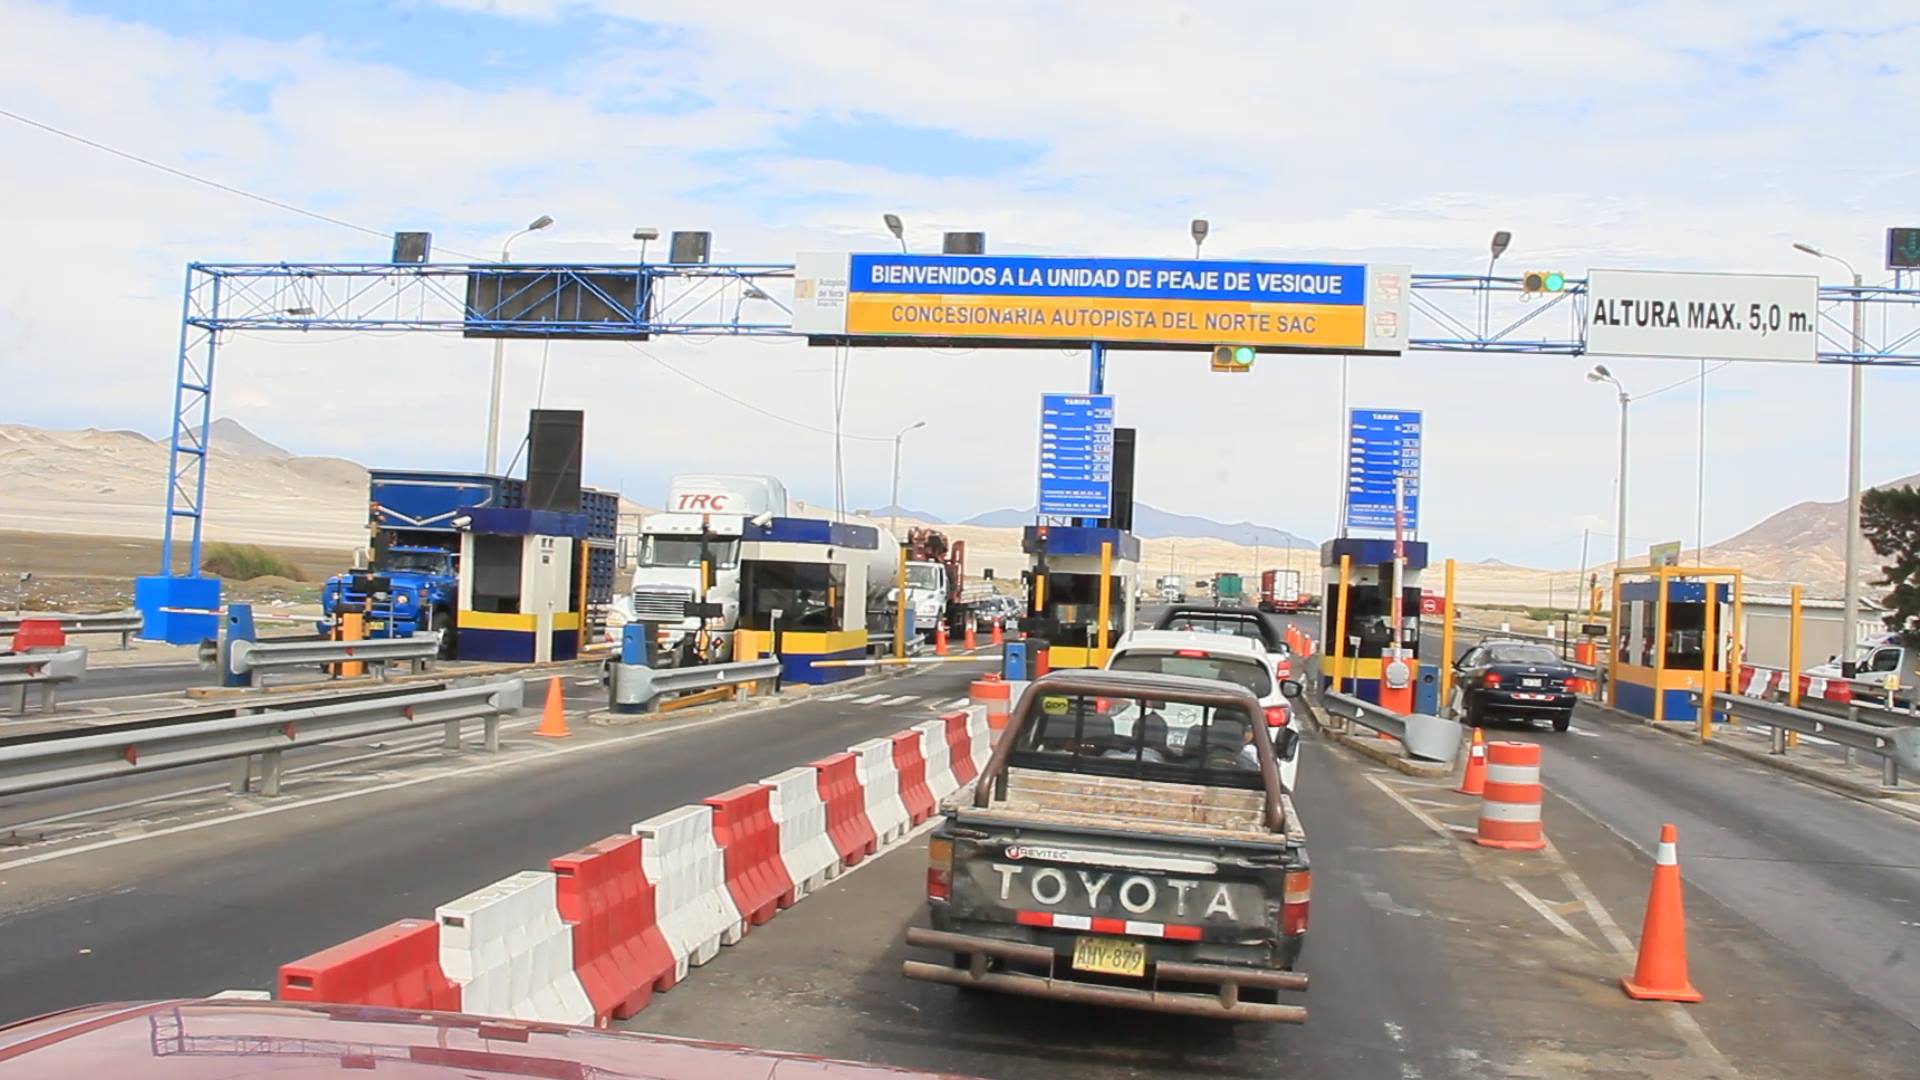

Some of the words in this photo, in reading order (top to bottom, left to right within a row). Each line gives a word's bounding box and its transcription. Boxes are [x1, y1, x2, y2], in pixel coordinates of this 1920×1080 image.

[871, 264, 996, 286] BIENVENIDOS
[1000, 268, 1014, 286] A
[1018, 268, 1047, 287] LA
[1048, 269, 1120, 288] UNIDAD
[1125, 270, 1151, 288] DE
[1156, 271, 1218, 290] PEAJE
[1224, 272, 1250, 291] DE
[1256, 273, 1342, 294] VESIQUE
[892, 305, 1046, 325] CONCESIONARIA
[1051, 309, 1157, 328] AUTOPISTA
[1162, 312, 1198, 330] DEL
[1205, 313, 1270, 332] NORTE
[1277, 315, 1317, 333] SAC
[1593, 299, 1680, 328] ALTURA
[1688, 302, 1742, 330] MAX.
[1749, 304, 1781, 336] 5,0
[1788, 311, 1814, 332] m.
[678, 494, 729, 511] TRC
[992, 863, 1239, 921] TOYOTA
